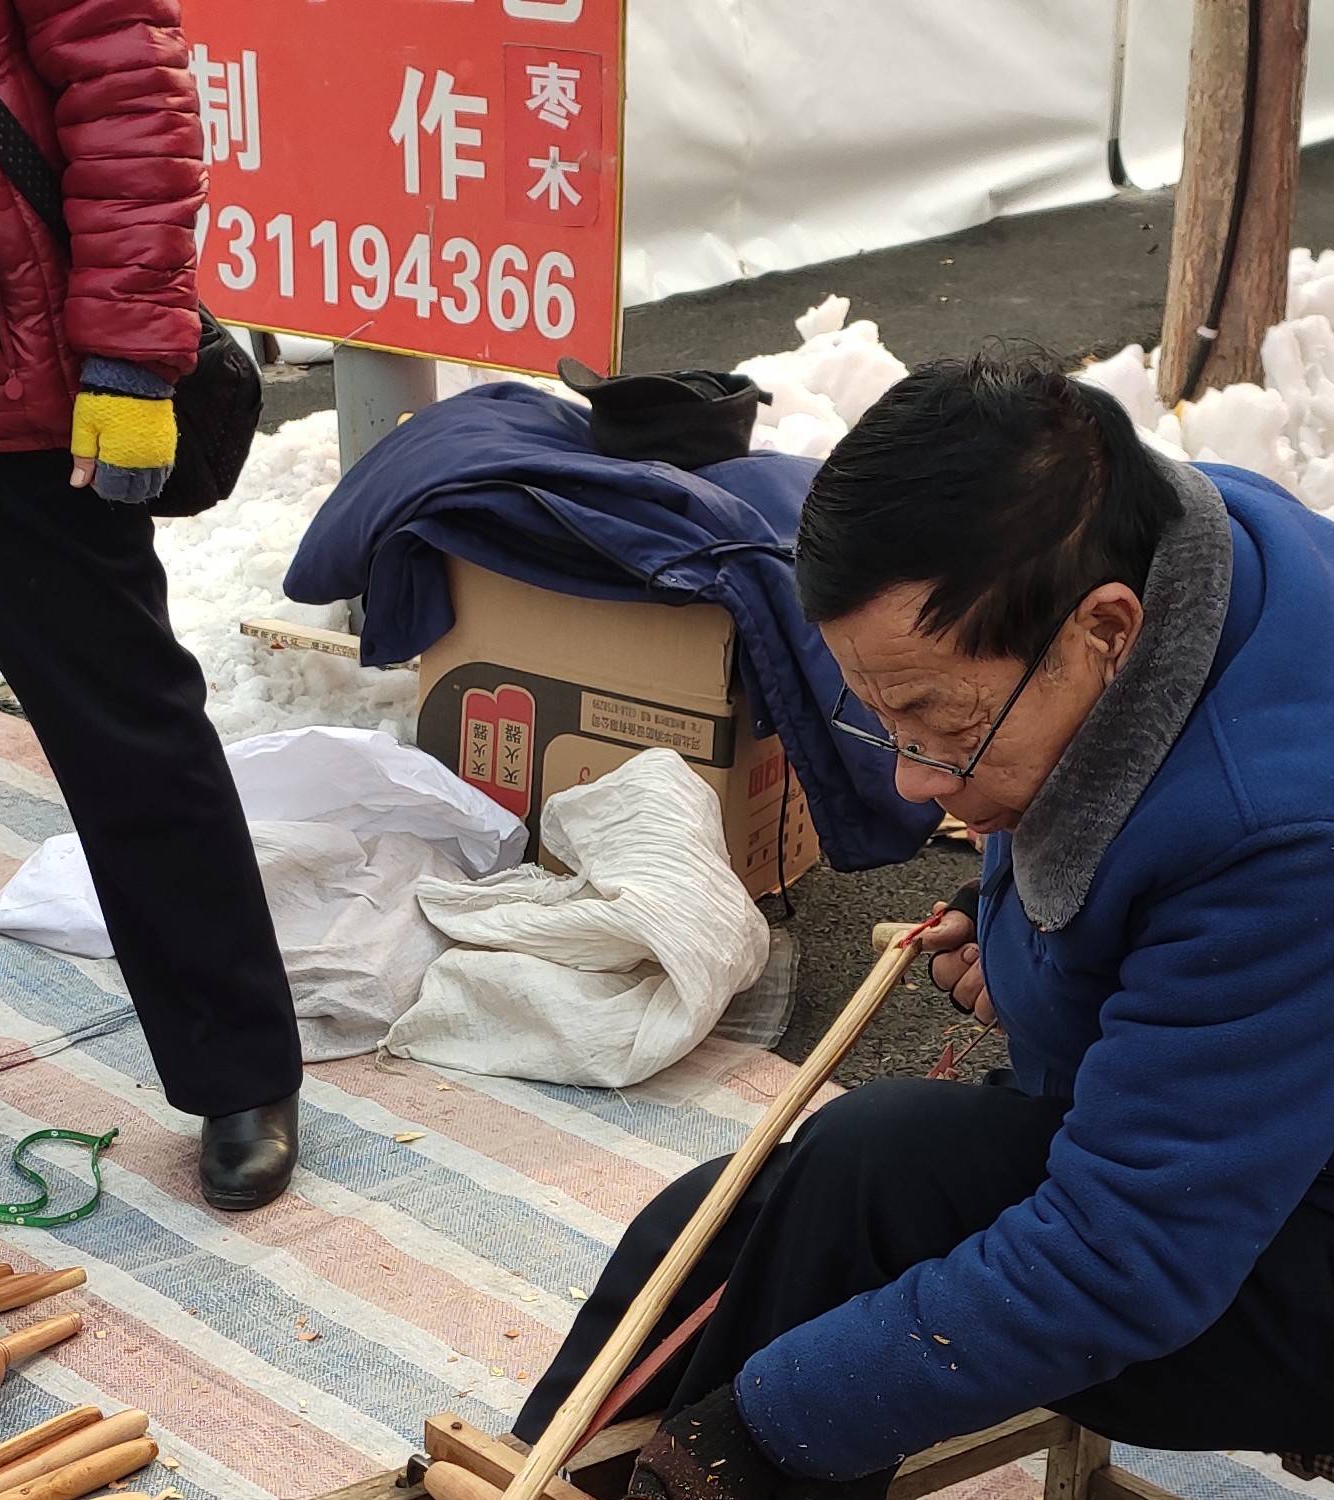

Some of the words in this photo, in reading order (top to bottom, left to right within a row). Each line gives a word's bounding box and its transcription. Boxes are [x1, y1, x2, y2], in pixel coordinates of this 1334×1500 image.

[524, 62, 583, 210] 枣木
[471, 723, 488, 777] 灭火器
[502, 723, 524, 785] 灭火器
